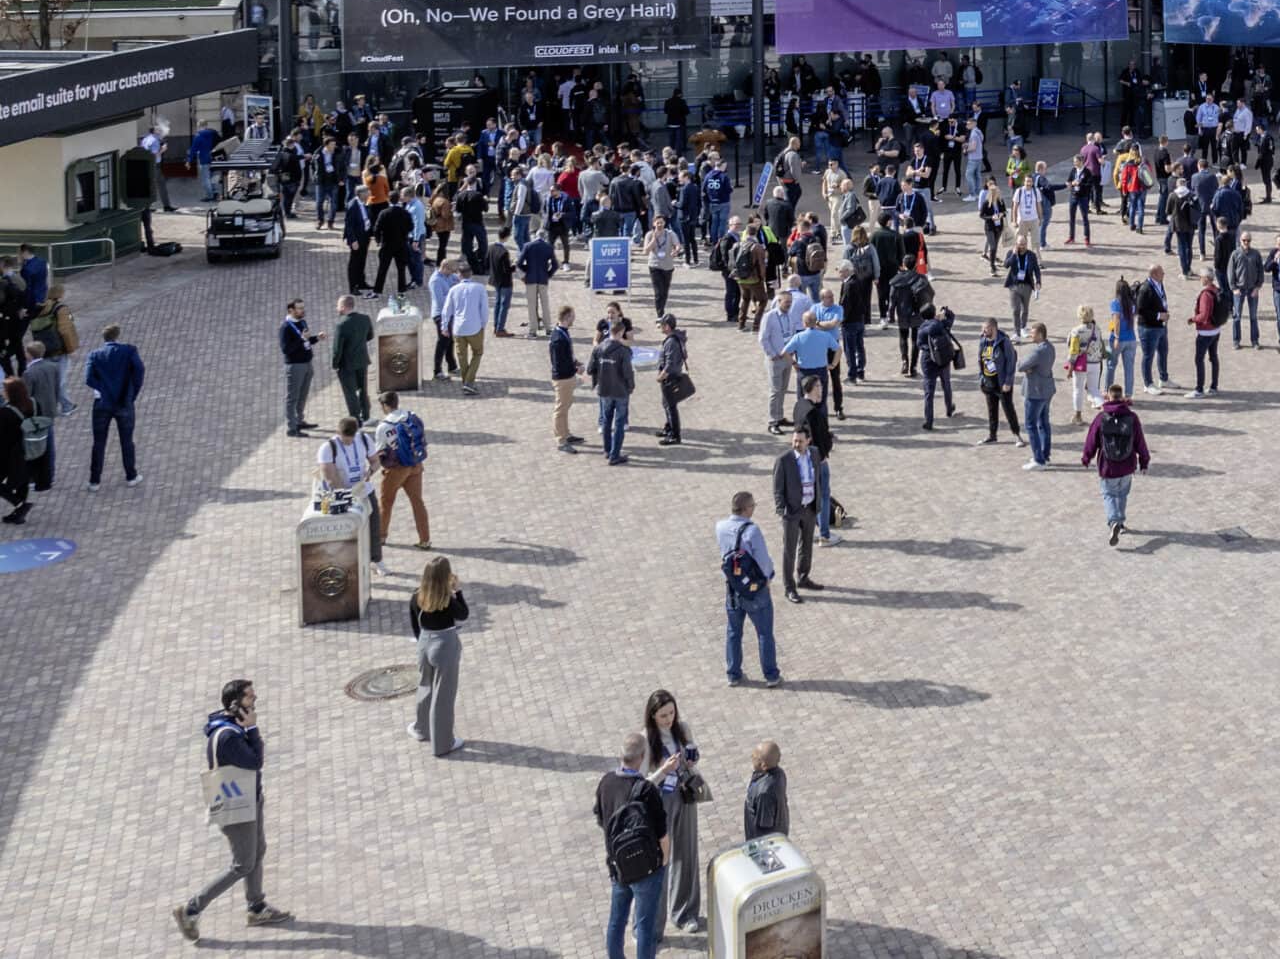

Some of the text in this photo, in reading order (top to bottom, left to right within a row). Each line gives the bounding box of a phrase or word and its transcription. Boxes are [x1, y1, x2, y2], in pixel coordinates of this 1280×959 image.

[381, 8, 420, 27] (Oh,
[504, 6, 561, 21] Found
[567, 8, 577, 19] a
[583, 4, 625, 21] Grey
[631, 2, 676, 20] Hair!)
[537, 45, 591, 57] CLOUDFEST
[599, 45, 619, 54] intel
[11, 94, 45, 116] email
[46, 88, 75, 108] suite
[75, 84, 91, 101] for
[92, 80, 117, 101] your
[119, 67, 175, 90] customers
[753, 888, 813, 914] DRUCKEN
